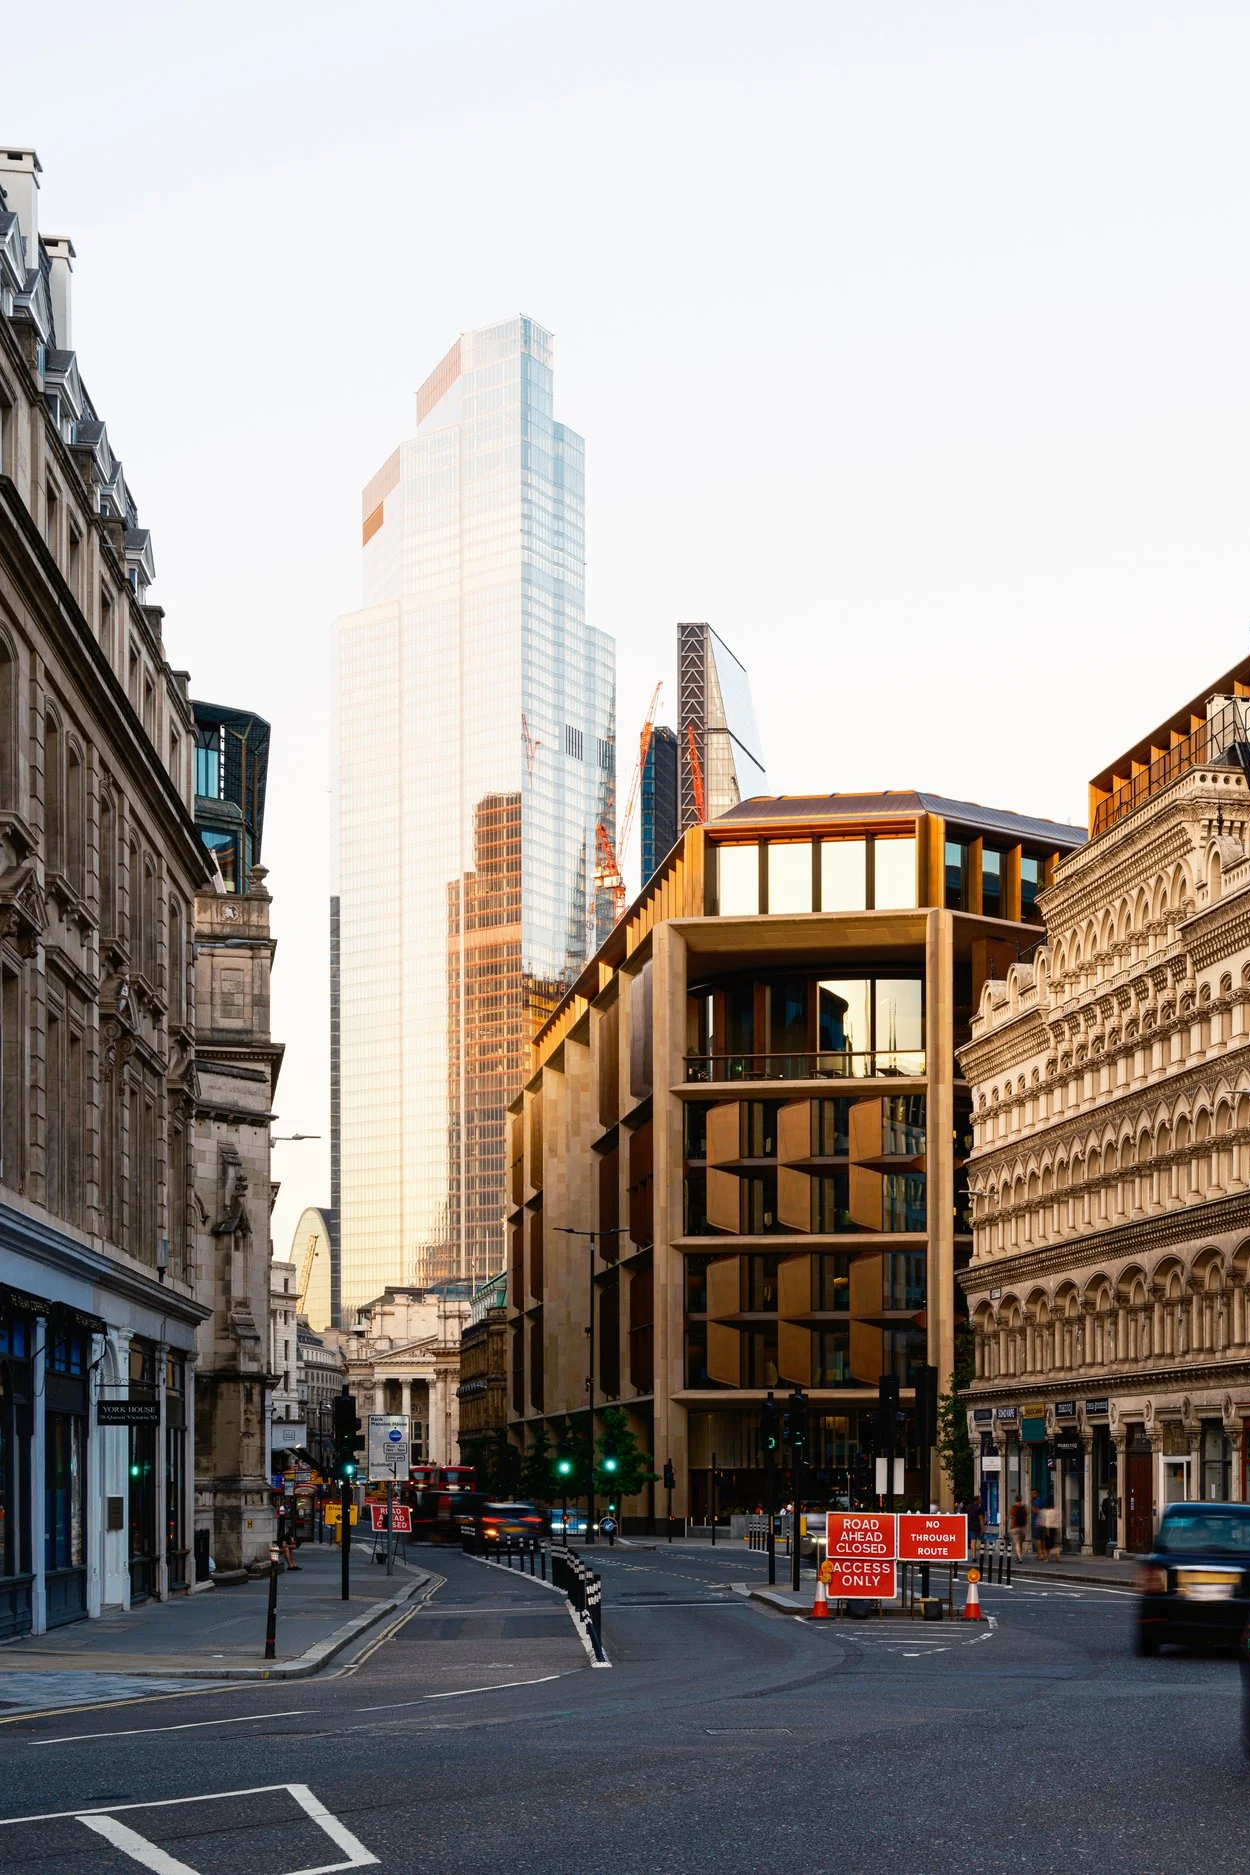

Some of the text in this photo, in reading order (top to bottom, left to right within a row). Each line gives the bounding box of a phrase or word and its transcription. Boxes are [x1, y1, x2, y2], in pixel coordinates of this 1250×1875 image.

[380, 1507, 402, 1515] RAD
[376, 1521, 408, 1529] CSED
[843, 1519, 879, 1530] ROAD
[925, 1520, 940, 1529] NO
[840, 1531, 883, 1542] AHEAD
[910, 1533, 956, 1542] THROUGH
[836, 1543, 887, 1554] CLOSED
[917, 1547, 948, 1556] ROUTE
[833, 1562, 891, 1574] ACCESS
[841, 1574, 881, 1587] ONLY
